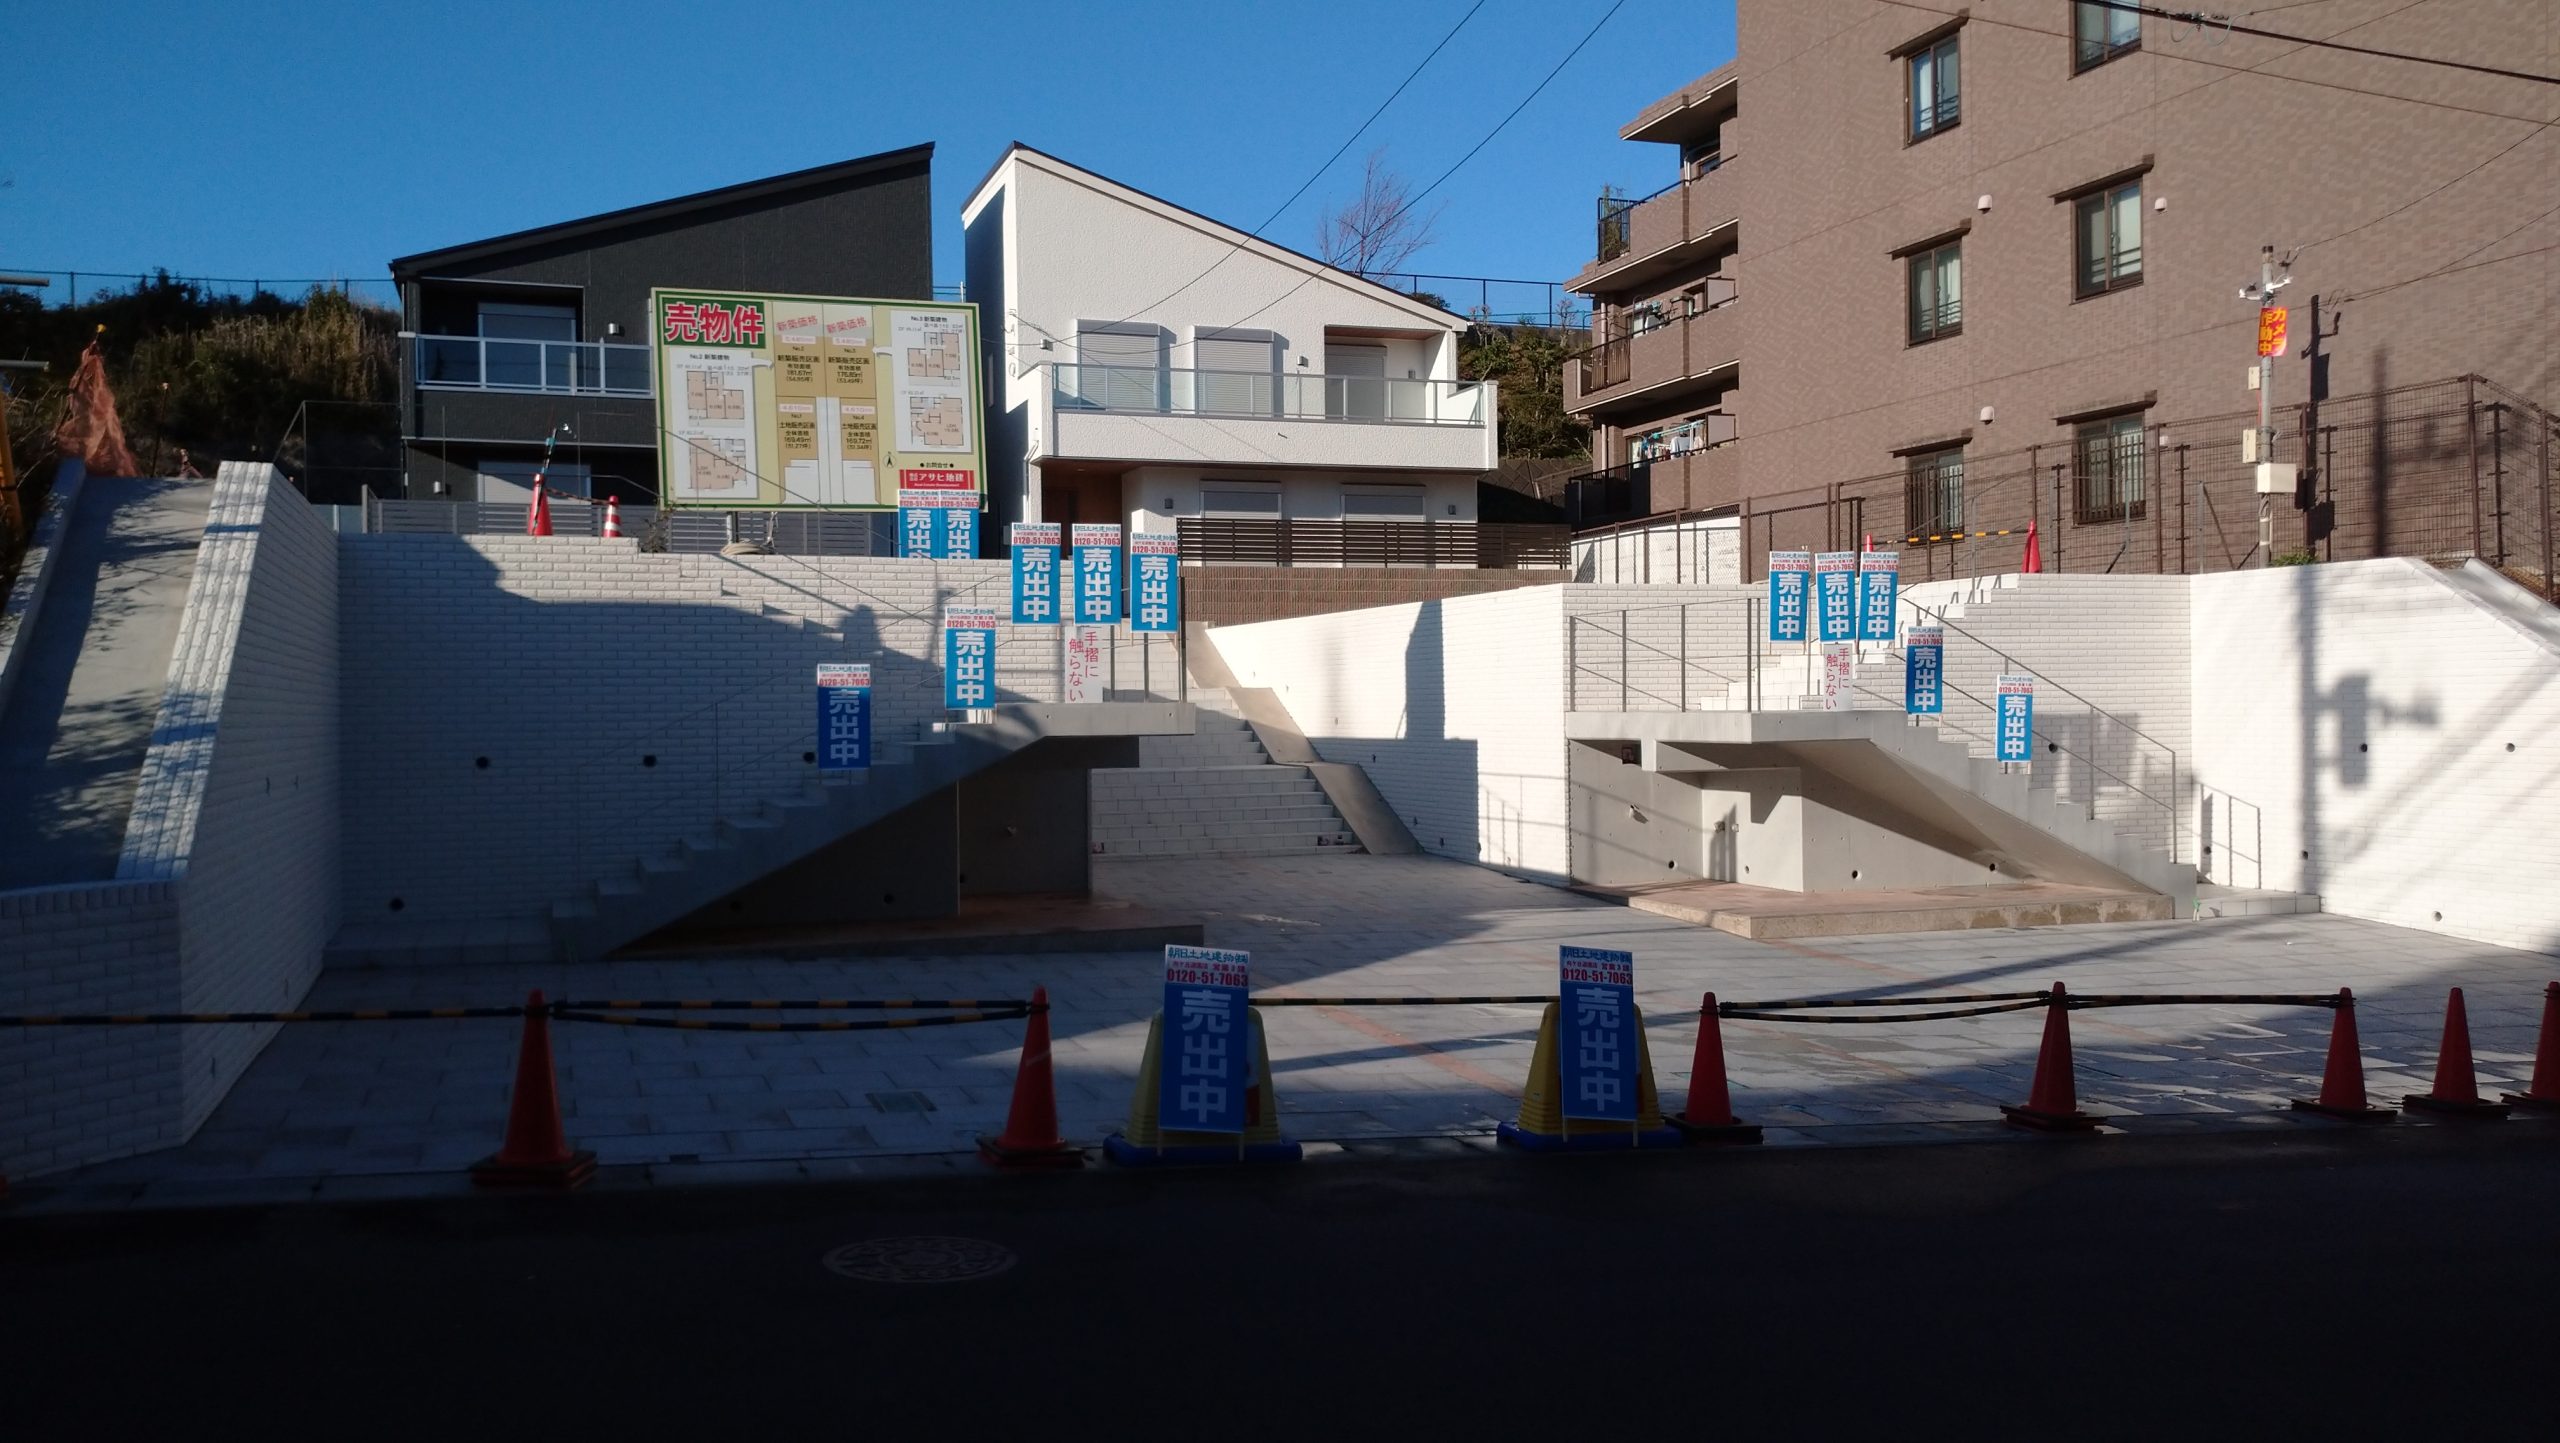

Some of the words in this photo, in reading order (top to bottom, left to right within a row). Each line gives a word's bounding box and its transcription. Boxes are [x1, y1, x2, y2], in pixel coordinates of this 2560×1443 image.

[664, 301, 764, 345] 売物件
[2272, 308, 2287, 350] カメラ
[907, 508, 932, 558] 売出
[947, 509, 971, 559] 売出
[1013, 536, 1061, 546] 0120-51-7063
[1074, 537, 1121, 546] 0120-51-7063
[1132, 546, 1178, 554] 0120-51-7063
[1013, 547, 1052, 621] 売出中
[1083, 548, 1112, 622] 売出中
[1140, 557, 1170, 629] 売出中
[1778, 574, 1802, 639] 売出中
[1825, 574, 1850, 639] 売出中
[1867, 573, 1892, 638] 売出中
[946, 620, 996, 628] 0120-51-7063
[819, 678, 870, 686] 0120-51-7063
[956, 632, 986, 706] 売出中
[1068, 638, 1084, 702] 触らない
[1084, 631, 1100, 678] 手摺に
[1826, 654, 1837, 710] 触らない
[1838, 648, 1850, 689] 手摺に
[1914, 647, 1936, 712] 売出中
[828, 690, 860, 766] 売出中
[2004, 696, 2026, 758] 売出中
[1166, 969, 1249, 987] 0120-51-7063
[1562, 968, 1633, 984] 0120-51-7063
[1180, 989, 1232, 1123] 売出中
[1576, 986, 1620, 1112] 売出中
